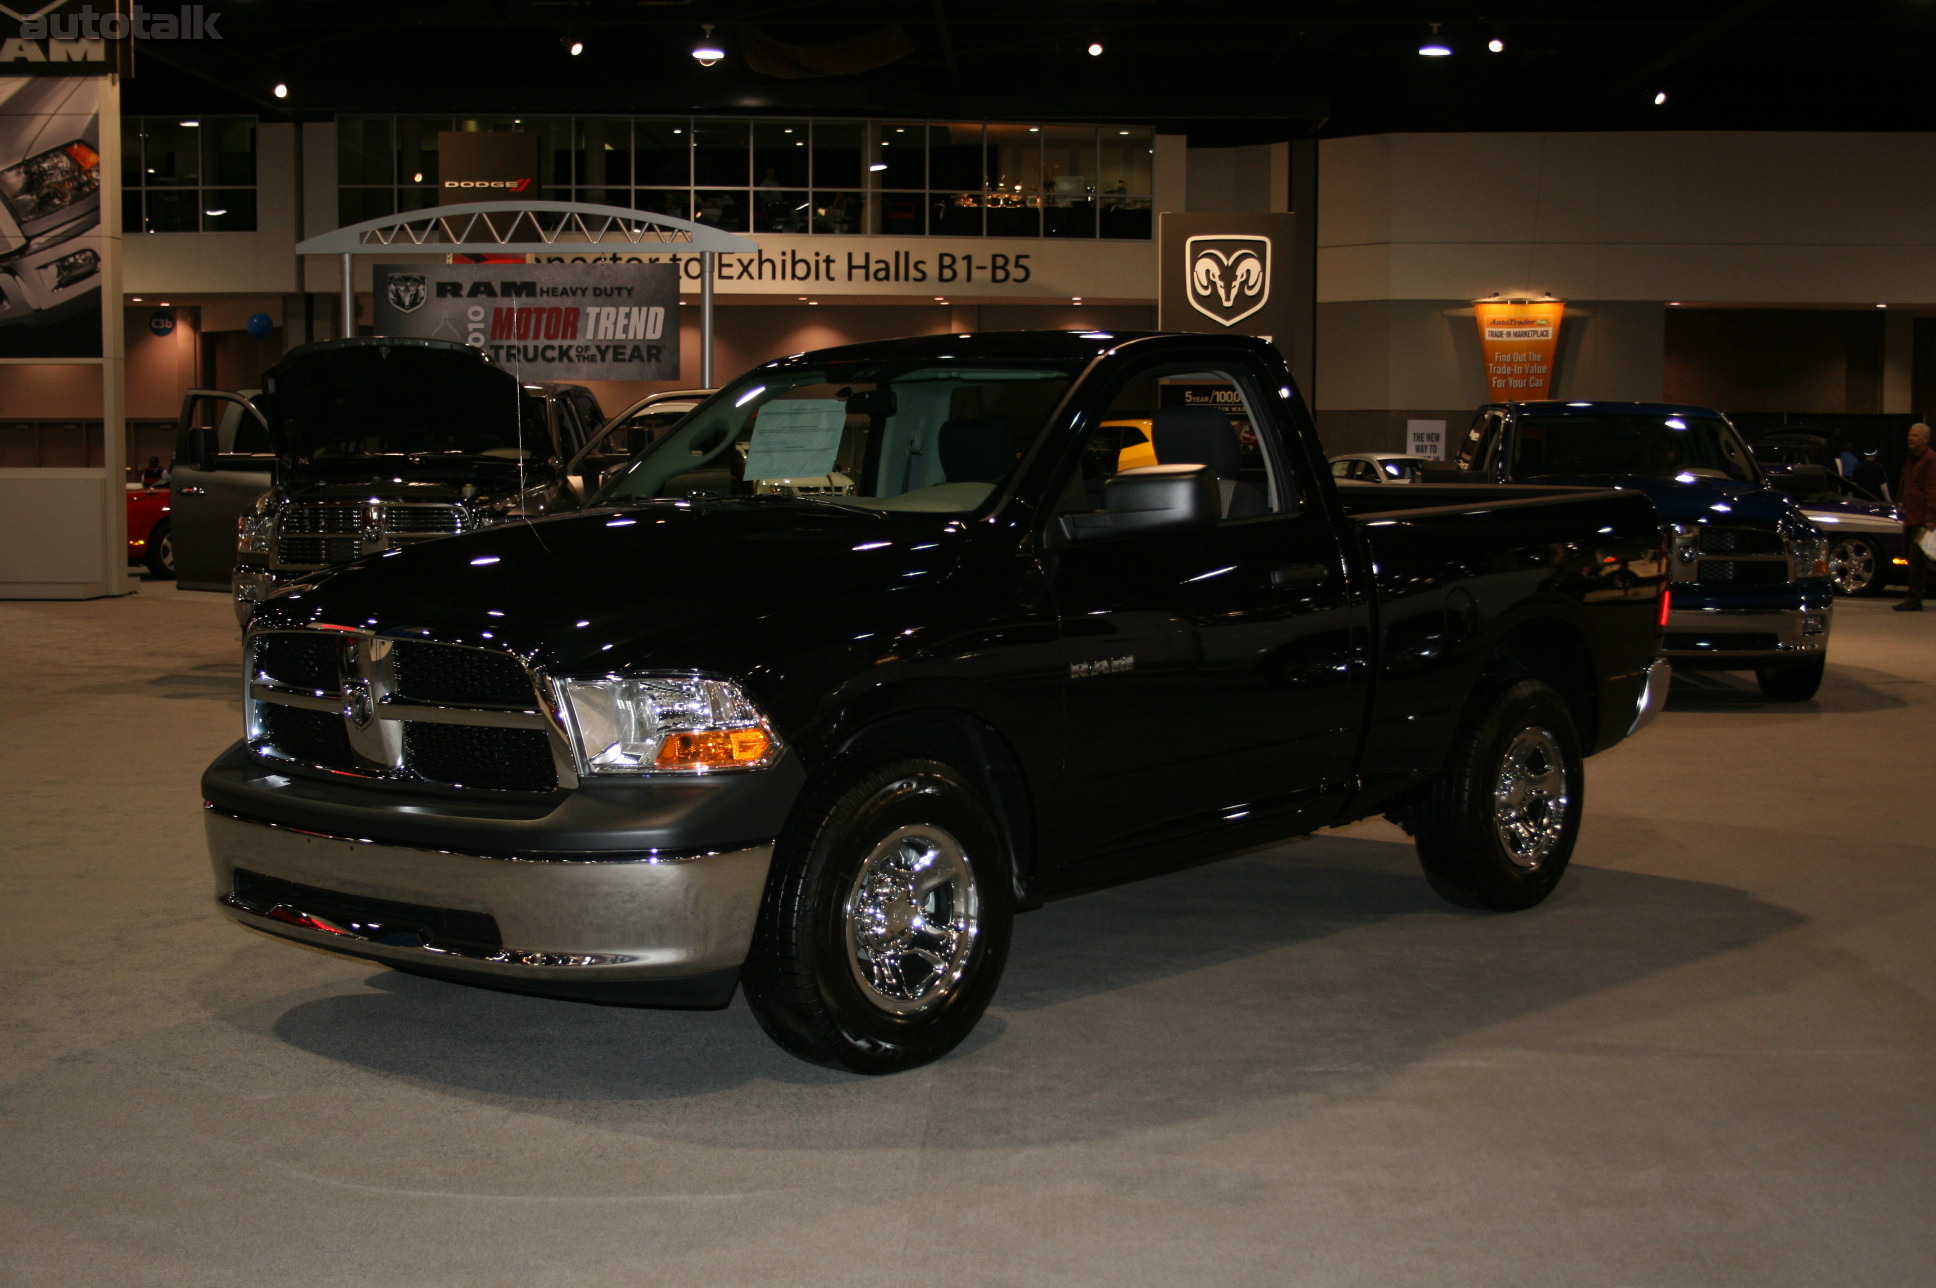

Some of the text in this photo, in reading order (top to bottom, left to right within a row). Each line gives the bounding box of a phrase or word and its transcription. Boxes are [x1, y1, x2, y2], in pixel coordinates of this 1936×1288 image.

[0, 37, 105, 62] AM
[717, 249, 836, 282] Exhibit
[847, 251, 928, 283] Halls
[937, 253, 1031, 284] B1-B5
[435, 281, 634, 298] RAM HEAVY DUTY
[150, 318, 174, 329] C3b
[467, 305, 485, 348] 010
[490, 306, 666, 341] MOTOR TREND
[1487, 329, 1550, 338] TRADE-IN MARKETPLACE
[489, 344, 663, 364] TRUCK OF THE YEAR
[1494, 351, 1542, 362] Find Out The
[1489, 363, 1547, 374] Trade-In Value
[1492, 376, 1544, 388] For Your Car
[1412, 432, 1441, 442] THE NEW
[1414, 444, 1438, 454] WAY TO
